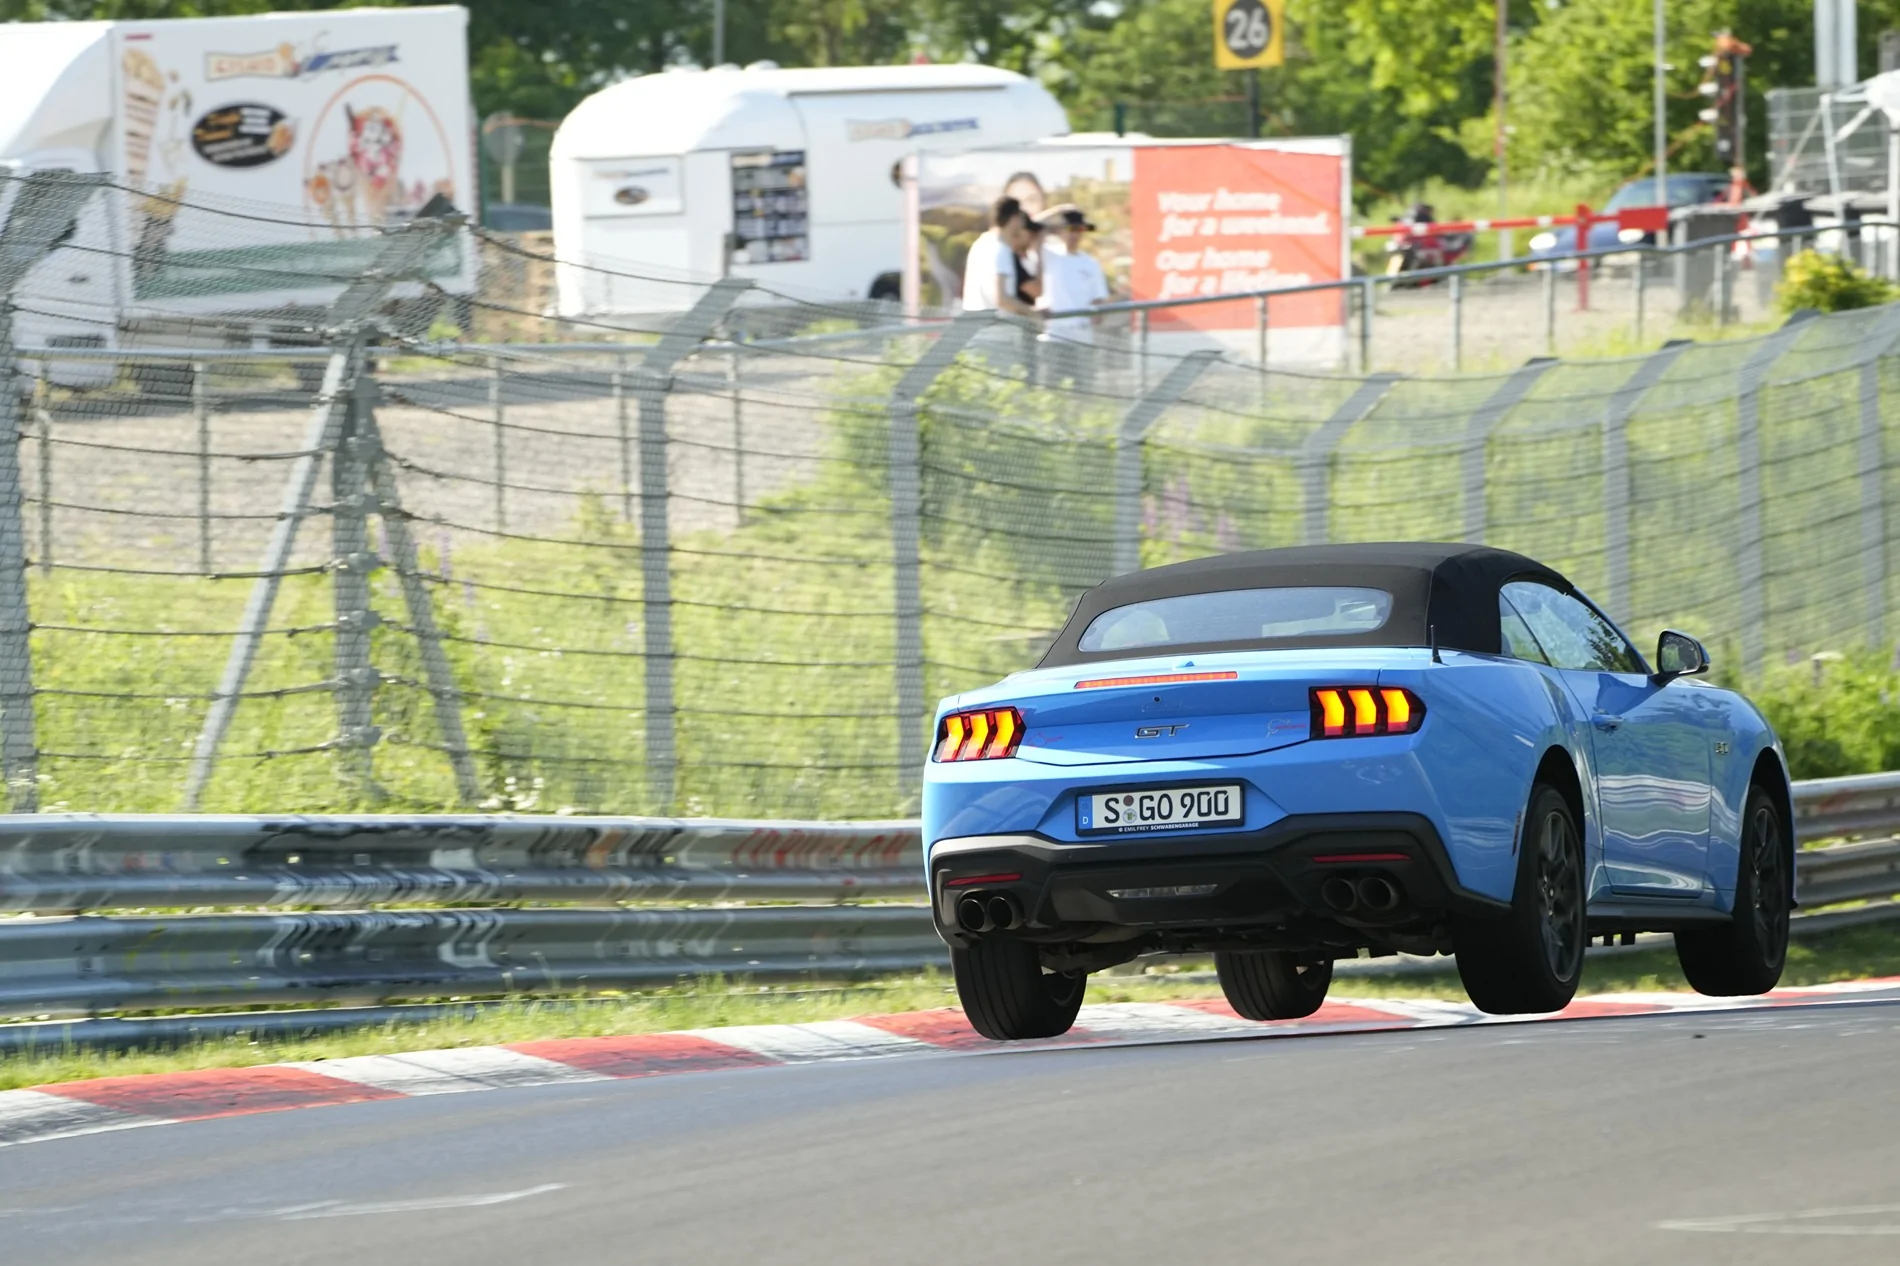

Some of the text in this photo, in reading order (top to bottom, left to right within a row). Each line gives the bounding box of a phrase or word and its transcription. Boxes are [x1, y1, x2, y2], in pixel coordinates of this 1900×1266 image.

[1227, 8, 1268, 49] 26
[1214, 187, 1282, 211] home
[1157, 213, 1198, 242] for
[1199, 217, 1217, 236] a
[1155, 246, 1272, 271] Our home
[1157, 271, 1198, 299] for
[1199, 275, 1217, 296] a
[1135, 724, 1190, 739] GT
[1104, 790, 1229, 824] S GO 900
[1082, 816, 1089, 825] D
[1150, 822, 1199, 831] SCHWABENGARAGE
